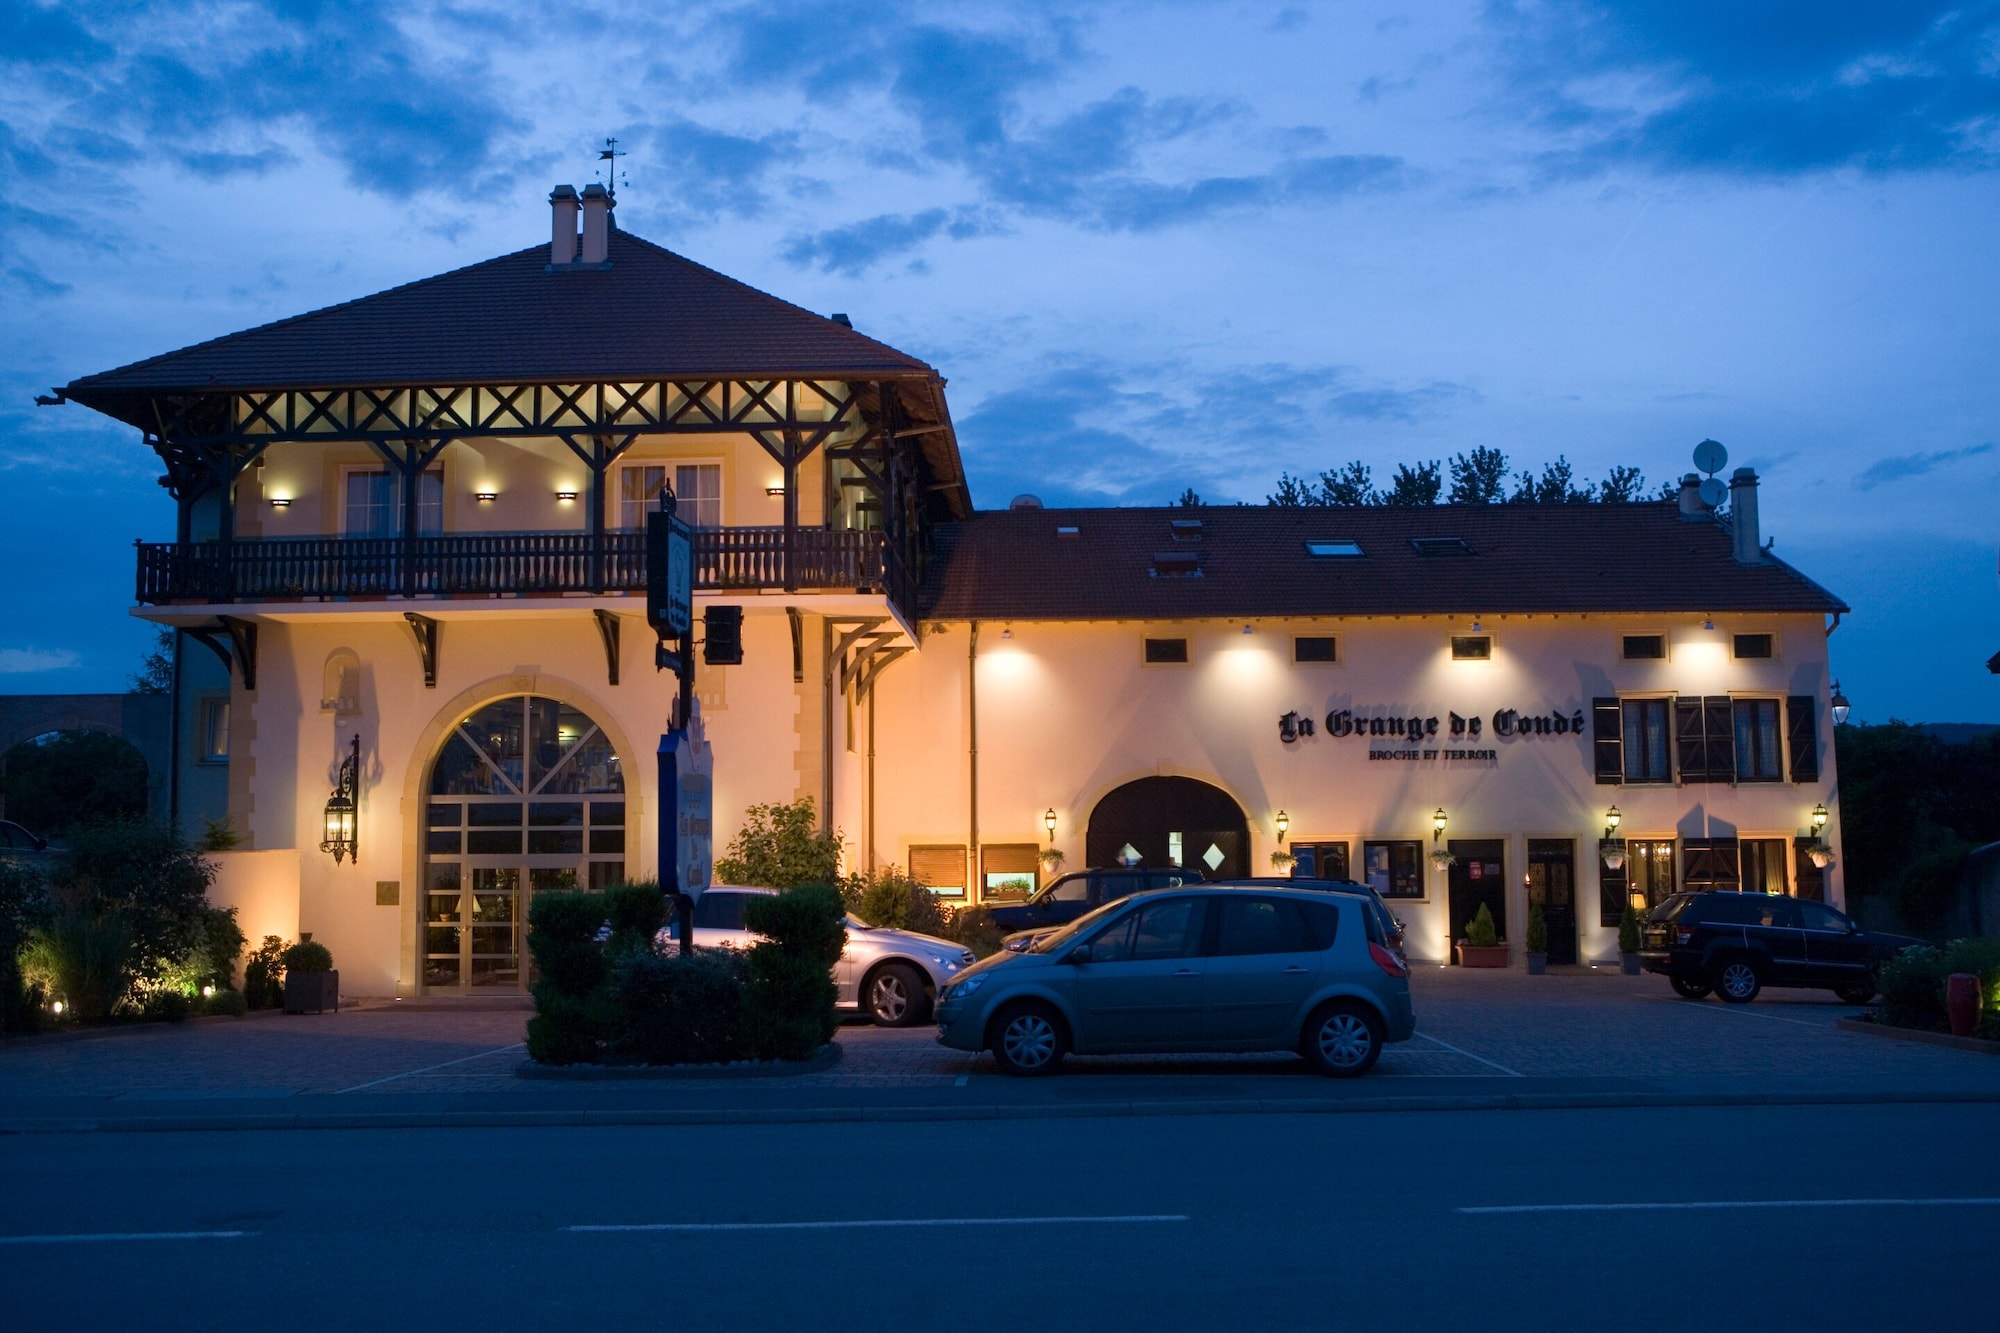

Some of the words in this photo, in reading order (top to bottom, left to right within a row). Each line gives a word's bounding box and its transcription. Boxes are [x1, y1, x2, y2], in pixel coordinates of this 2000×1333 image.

[1279, 710, 1315, 743] La
[1325, 709, 1439, 743] Grange
[1449, 710, 1482, 735] de
[1492, 708, 1585, 736] Condé
[1369, 750, 1420, 761] BROCHE
[1423, 750, 1439, 760] ET
[1444, 750, 1497, 760] TERROIR
